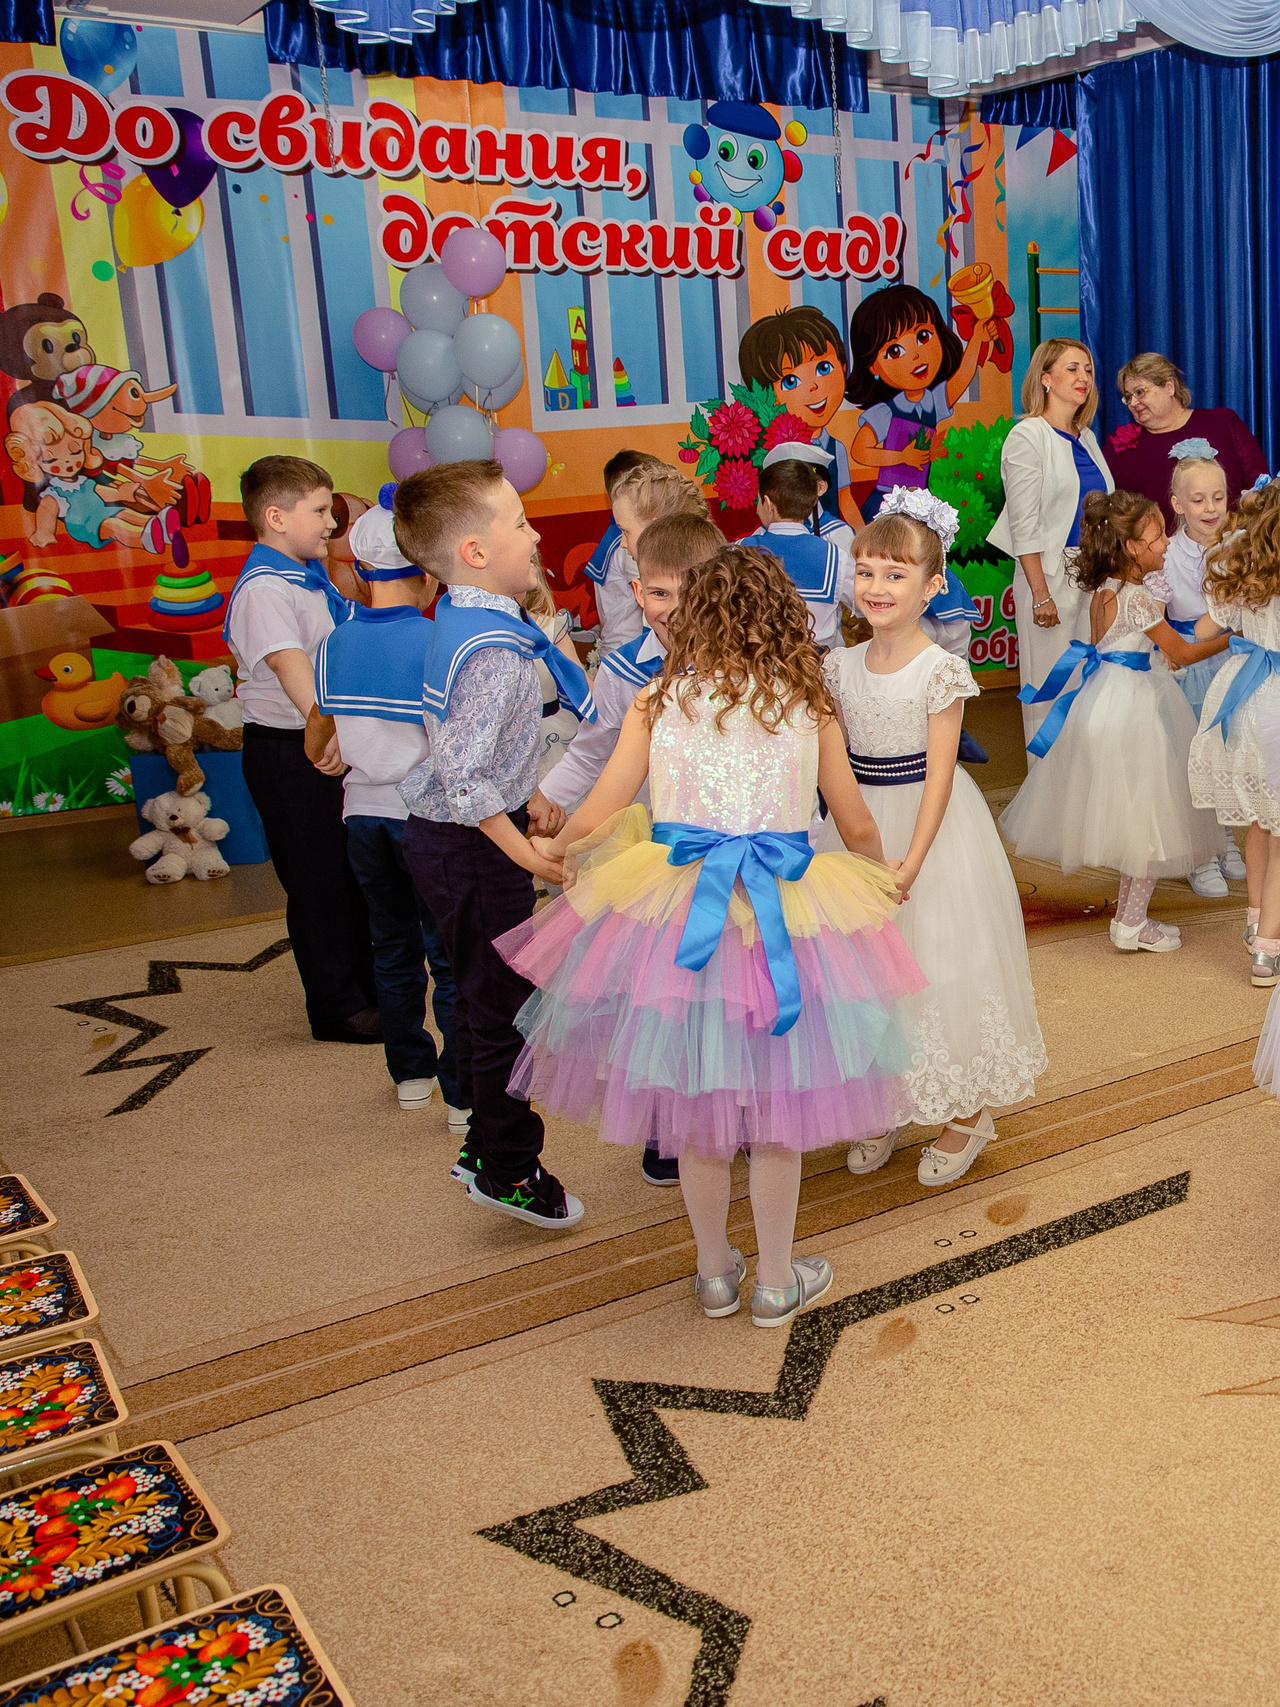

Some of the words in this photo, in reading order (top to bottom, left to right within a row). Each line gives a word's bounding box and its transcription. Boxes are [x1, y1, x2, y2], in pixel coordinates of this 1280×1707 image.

[3, 72, 178, 163] До
[206, 92, 643, 193] свидания,
[766, 214, 900, 276] сад!
